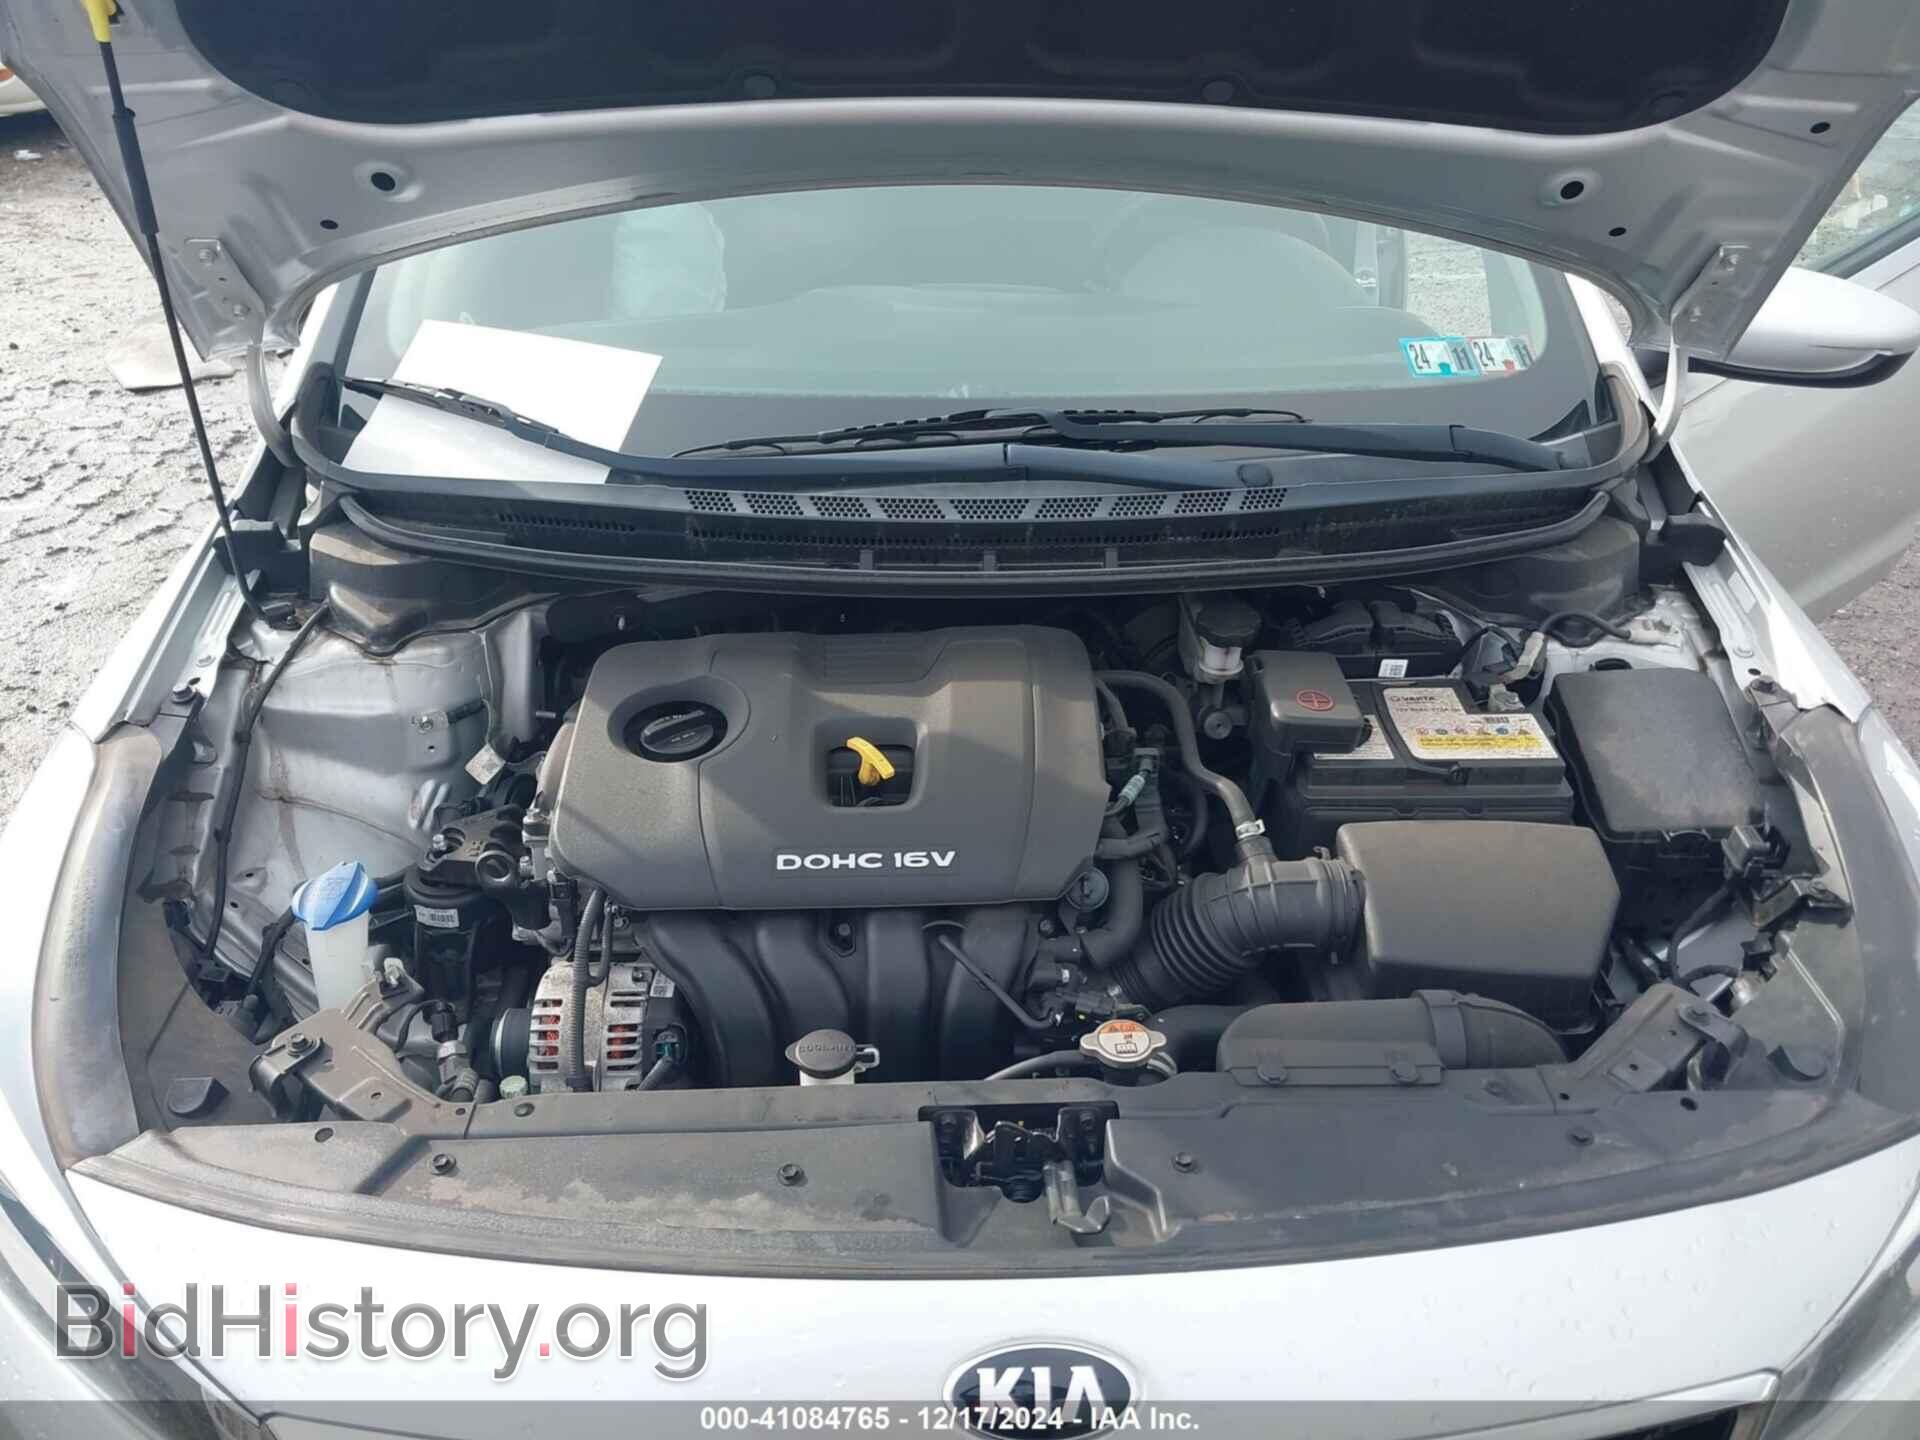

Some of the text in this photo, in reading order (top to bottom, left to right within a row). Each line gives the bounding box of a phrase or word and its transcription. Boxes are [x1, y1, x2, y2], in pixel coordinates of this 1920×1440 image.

[1409, 343, 1473, 371] 24 11
[1473, 341, 1496, 367] 24
[776, 851, 956, 870] DOHC 16V
[976, 1365, 1108, 1424] KIA
